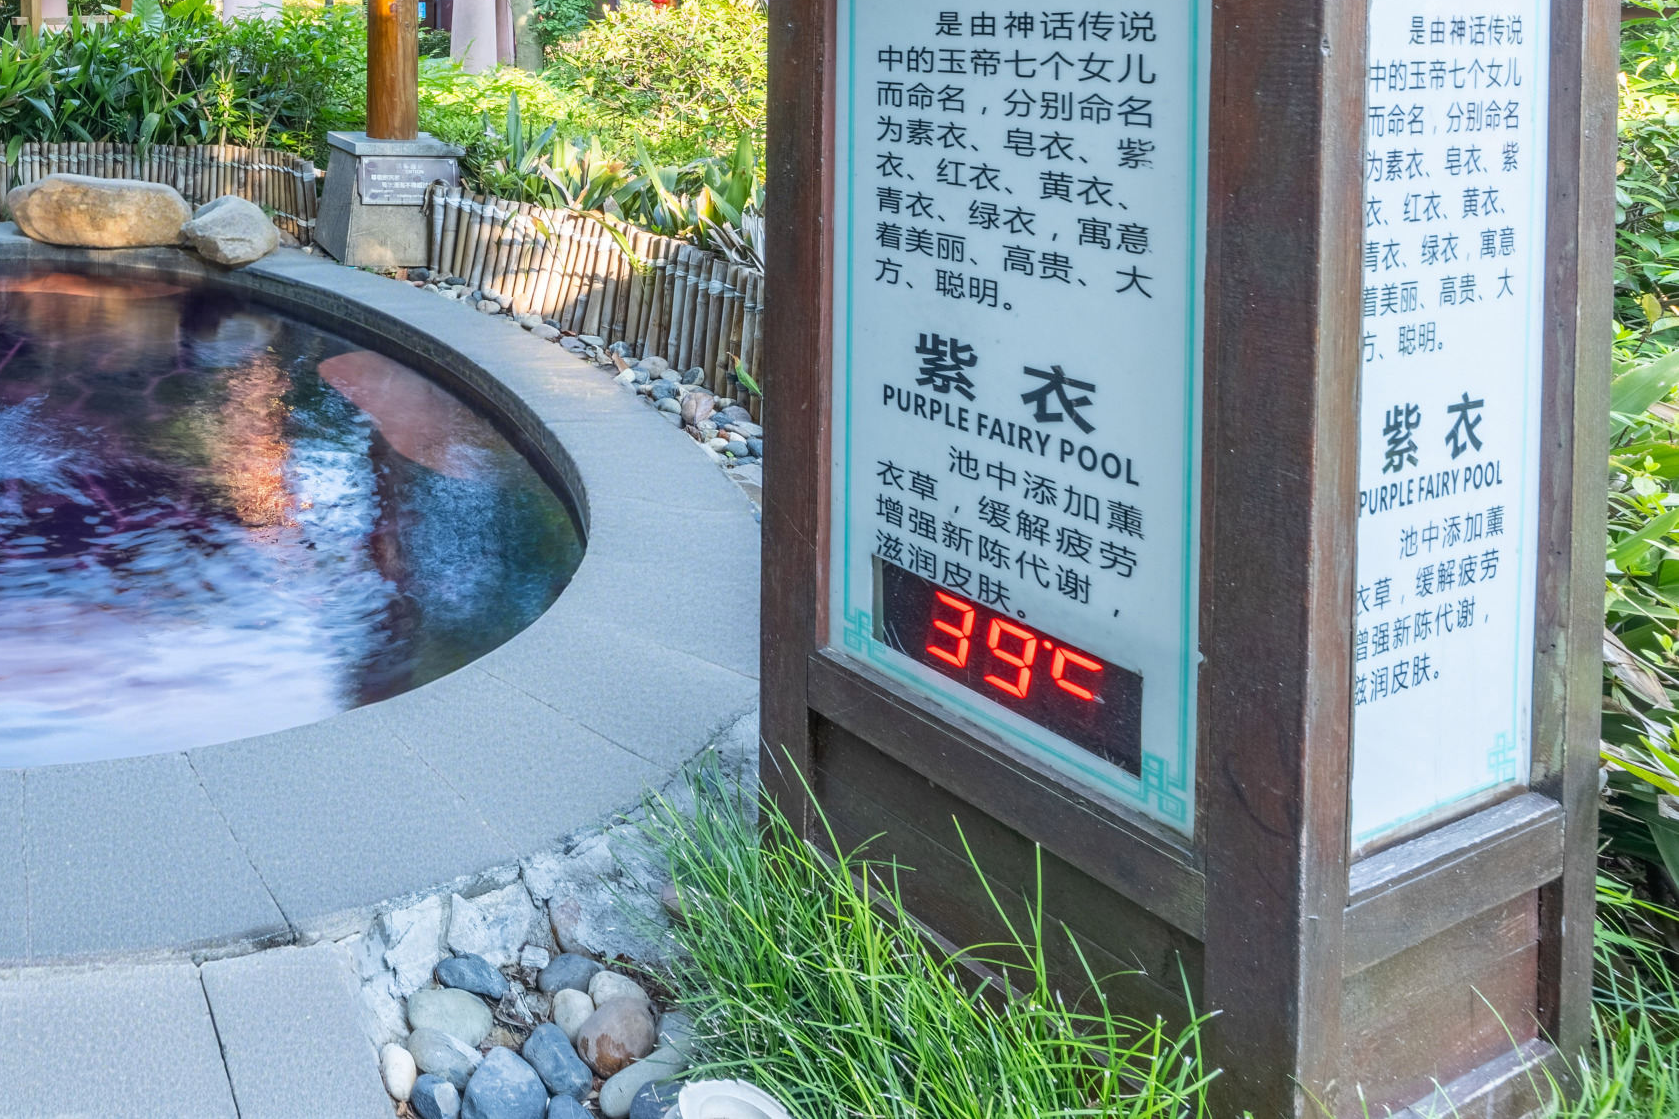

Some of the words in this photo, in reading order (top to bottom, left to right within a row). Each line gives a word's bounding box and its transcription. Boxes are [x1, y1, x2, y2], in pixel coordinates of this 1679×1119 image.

[934, 10, 1157, 43] 是由神话传说
[1408, 15, 1523, 46] 是由神话传说
[877, 44, 1157, 85] 中的玉帝七个女儿
[1369, 57, 1522, 93] 中的玉帝七个女儿
[876, 80, 1153, 129] 而命名，分别命名
[876, 115, 1156, 170] 为素衣、皂衣、紫
[875, 150, 1128, 211] 衣、红衣、黄衣、
[875, 186, 1152, 256] 青衣、绿衣，寓意
[874, 257, 1013, 311] 方、聪明。
[875, 220, 1153, 299] 着美丽、高贵、大
[883, 383, 970, 433] PURPLE
[976, 412, 1052, 458] FAIRY
[1059, 437, 1140, 487] POOL
[948, 445, 1145, 541] 池中添加薰
[1359, 478, 1415, 518] PURPLE
[1418, 468, 1460, 503] FAIRY
[1463, 459, 1503, 493] POOL
[876, 460, 1138, 579] 衣草，缓解疲劳
[875, 492, 1120, 618] 增强新陈代谢，
[877, 528, 1027, 619] 滋润皮肤。
